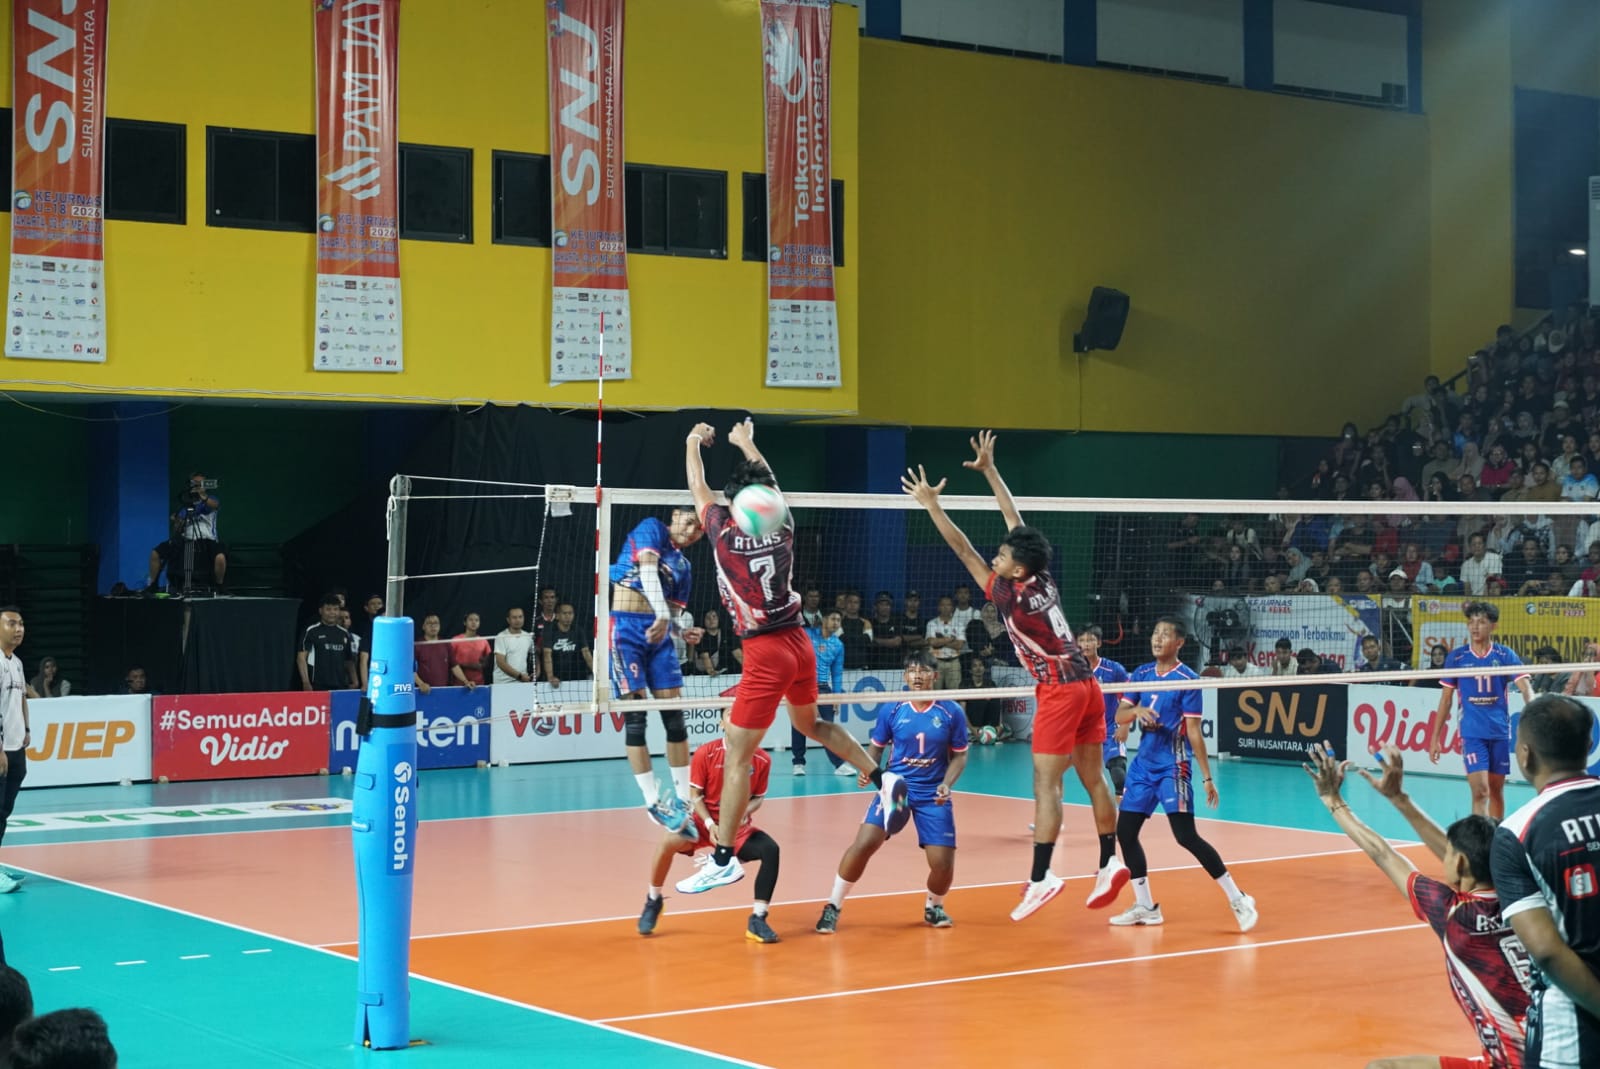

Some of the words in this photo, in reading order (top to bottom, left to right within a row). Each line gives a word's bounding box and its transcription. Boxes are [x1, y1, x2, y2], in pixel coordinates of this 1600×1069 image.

[342, 0, 381, 59] JAY
[82, 9, 95, 113] NUSANTARA
[343, 71, 381, 153] PAM
[559, 11, 600, 206] SNJ
[604, 67, 614, 156] NUSANTARA
[81, 120, 94, 159] SURI
[811, 58, 825, 212] Indonesia
[794, 115, 810, 228] Telkom
[35, 191, 101, 207] KEJURNAS
[35, 203, 66, 215] U-18
[73, 206, 100, 217] 2026
[338, 214, 396, 227] KEJURNAS
[371, 227, 395, 238] 2026
[734, 531, 781, 550] ATLAS
[749, 554, 776, 602] 7
[1048, 604, 1073, 642] 4
[629, 662, 639, 678] 9
[1475, 675, 1492, 693] 11
[160, 705, 327, 731] #SemuaAdaDi
[1150, 694, 1159, 710] 7
[1234, 689, 1328, 737] SNJ
[26, 720, 135, 762] JIEP
[336, 710, 480, 750] mten
[916, 732, 926, 754] 1
[1238, 737, 1256, 748] SURI
[1257, 739, 1303, 752] NUSANTARA
[200, 733, 289, 766] Vidio
[1466, 752, 1478, 766] 11
[393, 786, 410, 870] Senoh
